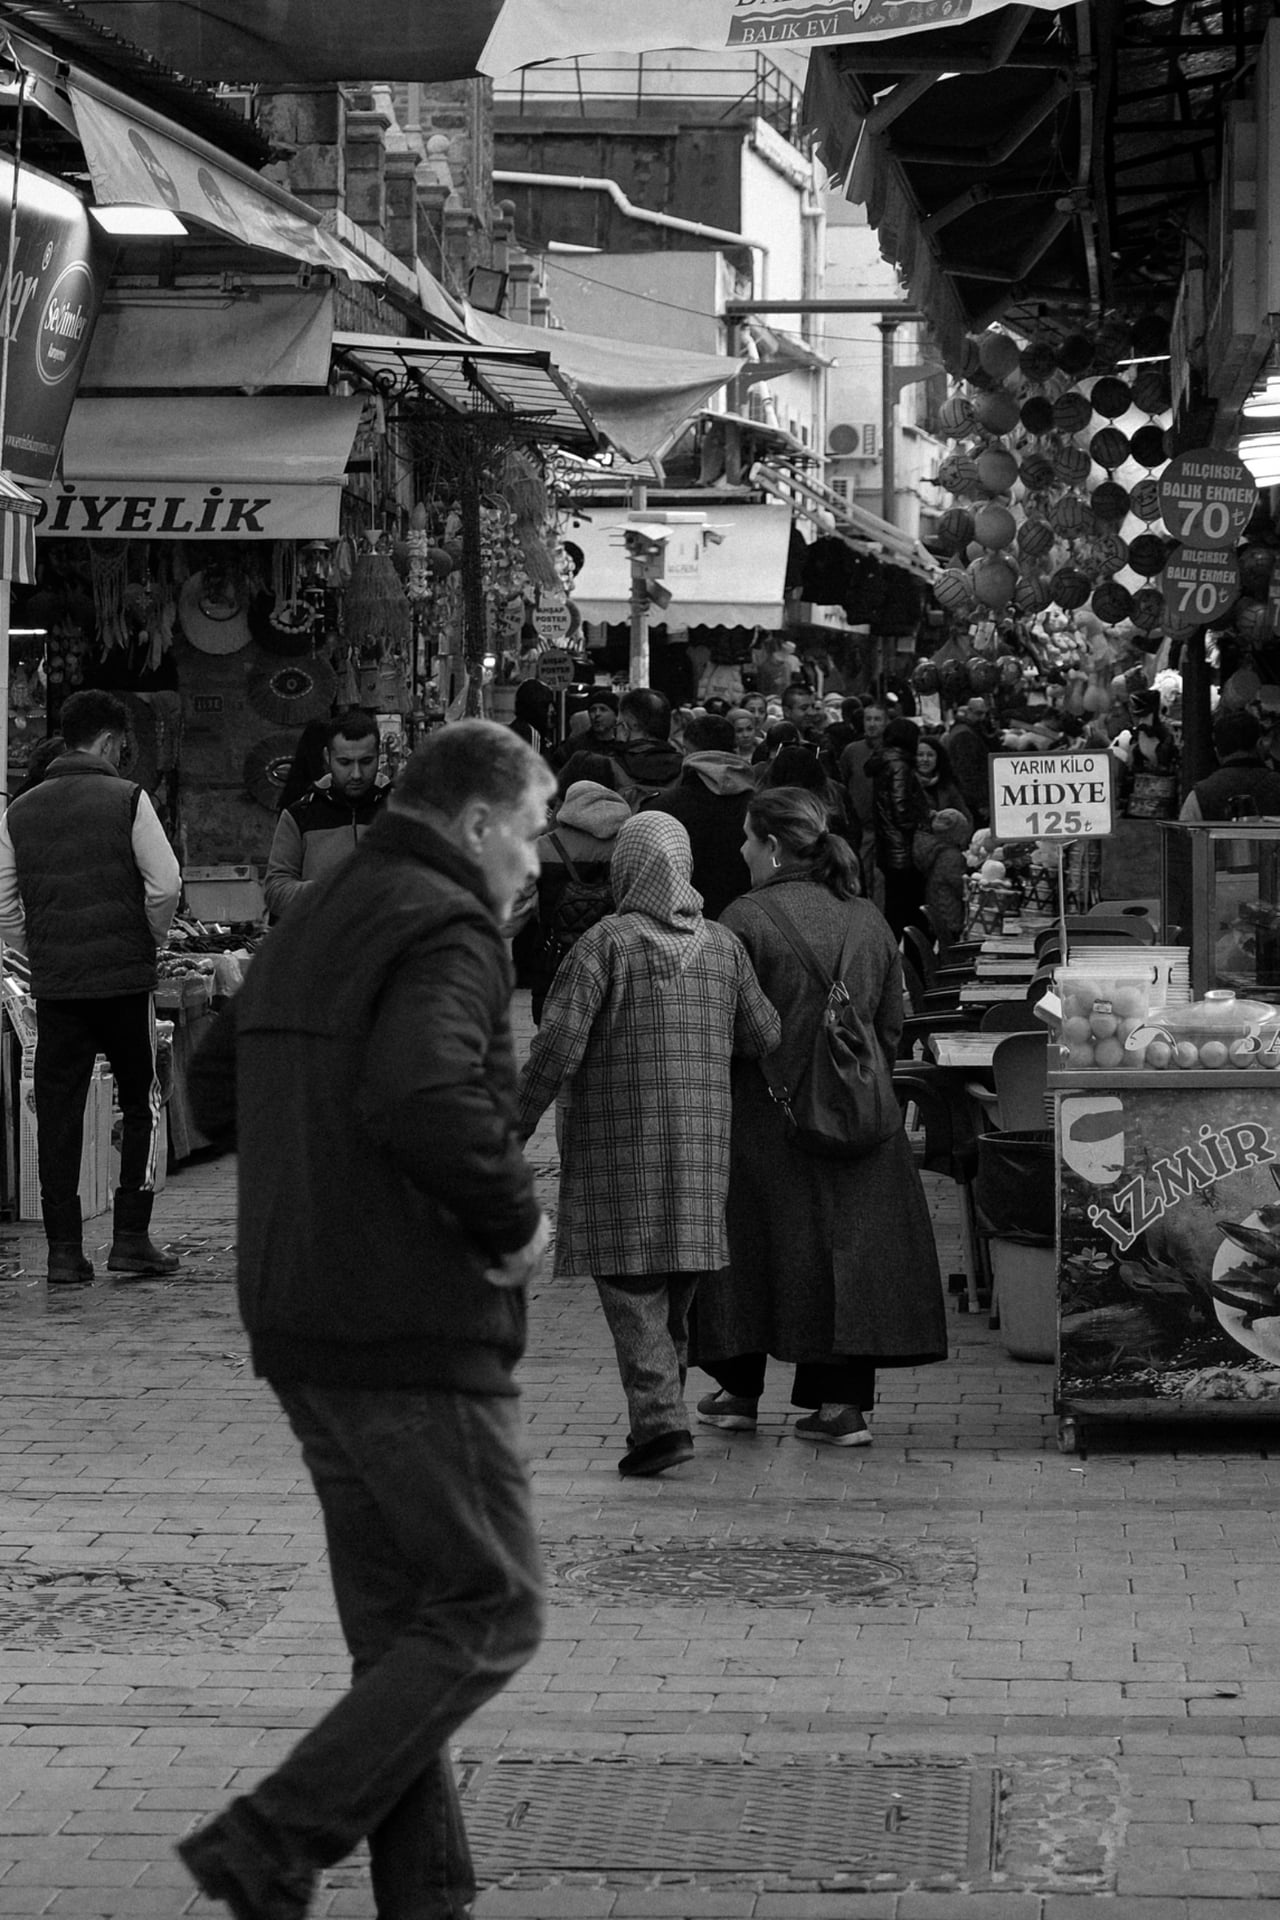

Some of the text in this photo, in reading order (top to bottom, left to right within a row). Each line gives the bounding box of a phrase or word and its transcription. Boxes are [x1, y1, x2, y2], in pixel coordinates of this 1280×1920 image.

[742, 14, 839, 43] BALIK EVİ
[1181, 462, 1244, 481] KILÇIKSIZ
[1162, 482, 1254, 503] BALIK EKMEK
[1182, 549, 1229, 565] KILÇIKSIZ
[1167, 566, 1236, 584] BALIK EKMEK
[541, 666, 570, 674] POSTER
[1010, 755, 1094, 775] YARIM KİLO
[1000, 779, 1106, 806] MİDYE
[1087, 1122, 1277, 1251] İZMİR
